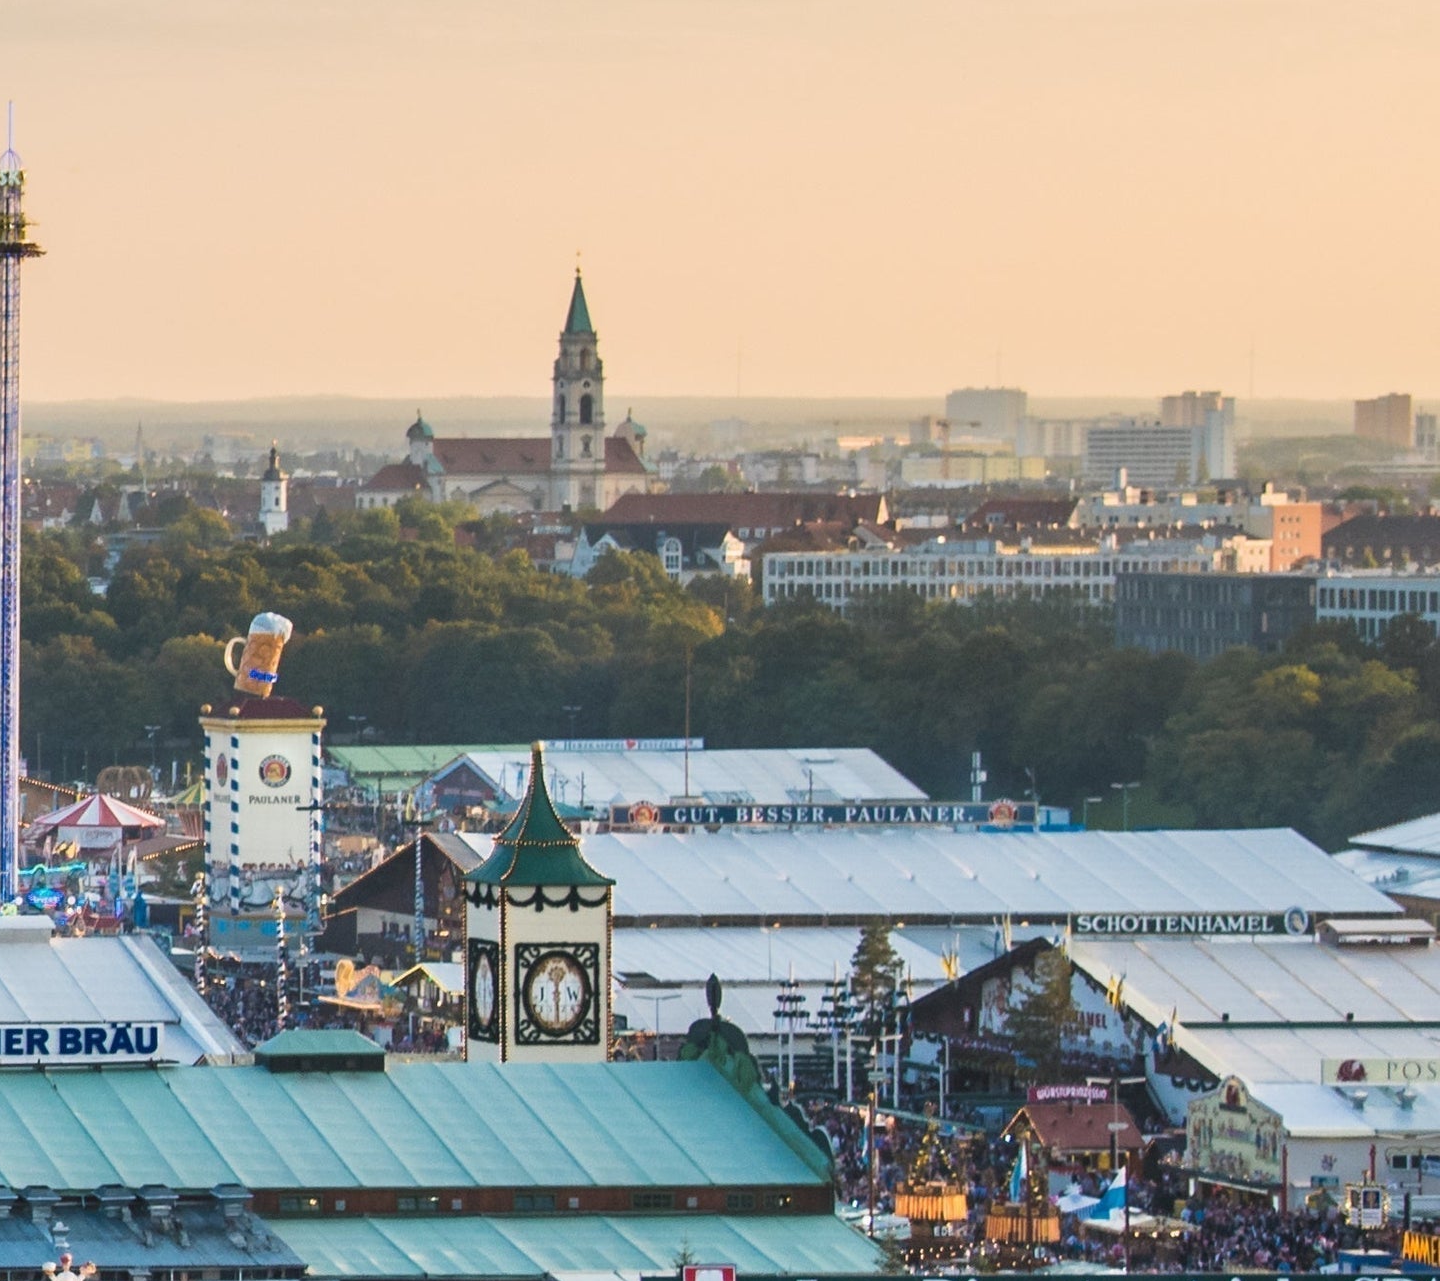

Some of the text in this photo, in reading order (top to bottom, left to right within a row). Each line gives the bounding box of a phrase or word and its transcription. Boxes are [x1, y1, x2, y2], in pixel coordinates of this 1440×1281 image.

[249, 795, 301, 805] PAULANER
[674, 807, 975, 826] GUT, BESSER, PAULANER.
[1077, 915, 1274, 934] SCHOTTENHAMEL
[59, 1022, 158, 1056] BRÄU
